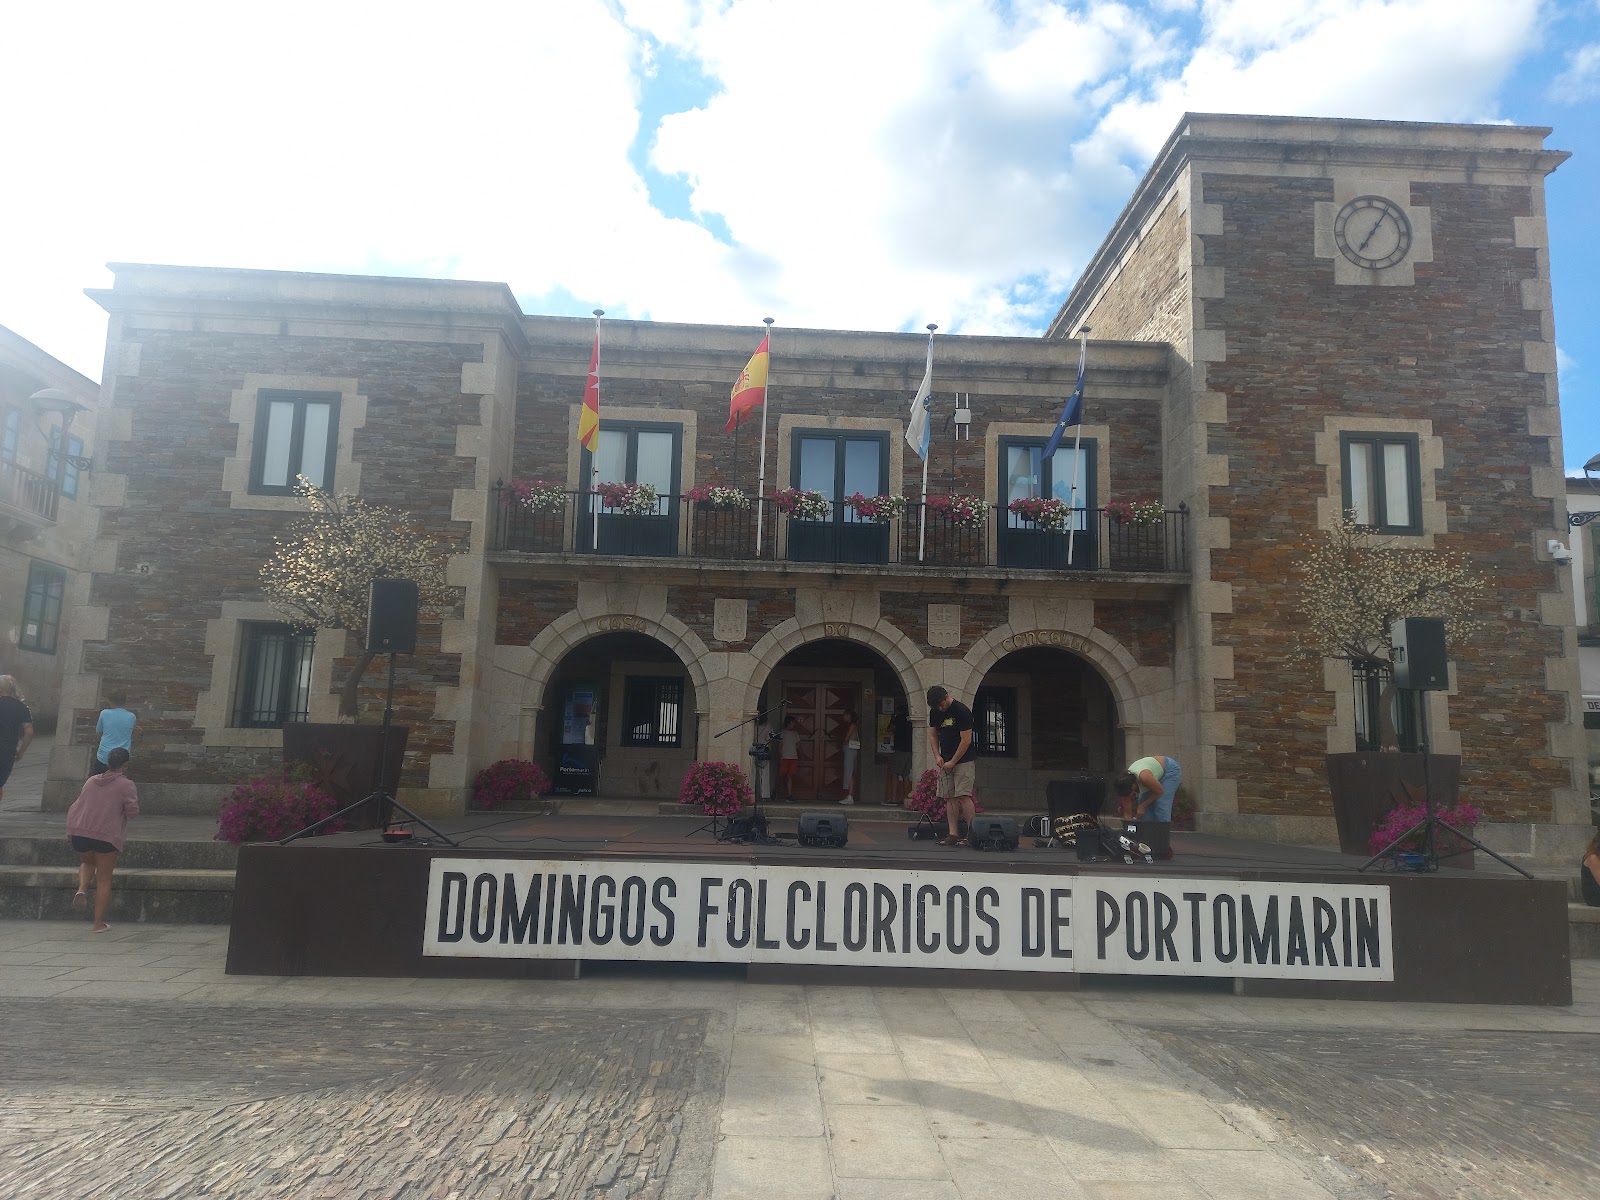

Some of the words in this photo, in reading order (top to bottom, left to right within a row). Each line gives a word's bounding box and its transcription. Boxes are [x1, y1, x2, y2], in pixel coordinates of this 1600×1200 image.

[596, 616, 648, 632] CASA
[825, 623, 849, 637] DO
[437, 871, 677, 947] DOMINGOS
[697, 877, 1000, 957] FOLCLORICOS
[1021, 887, 1073, 959] DE
[1096, 890, 1381, 968] PORTOMARIN
